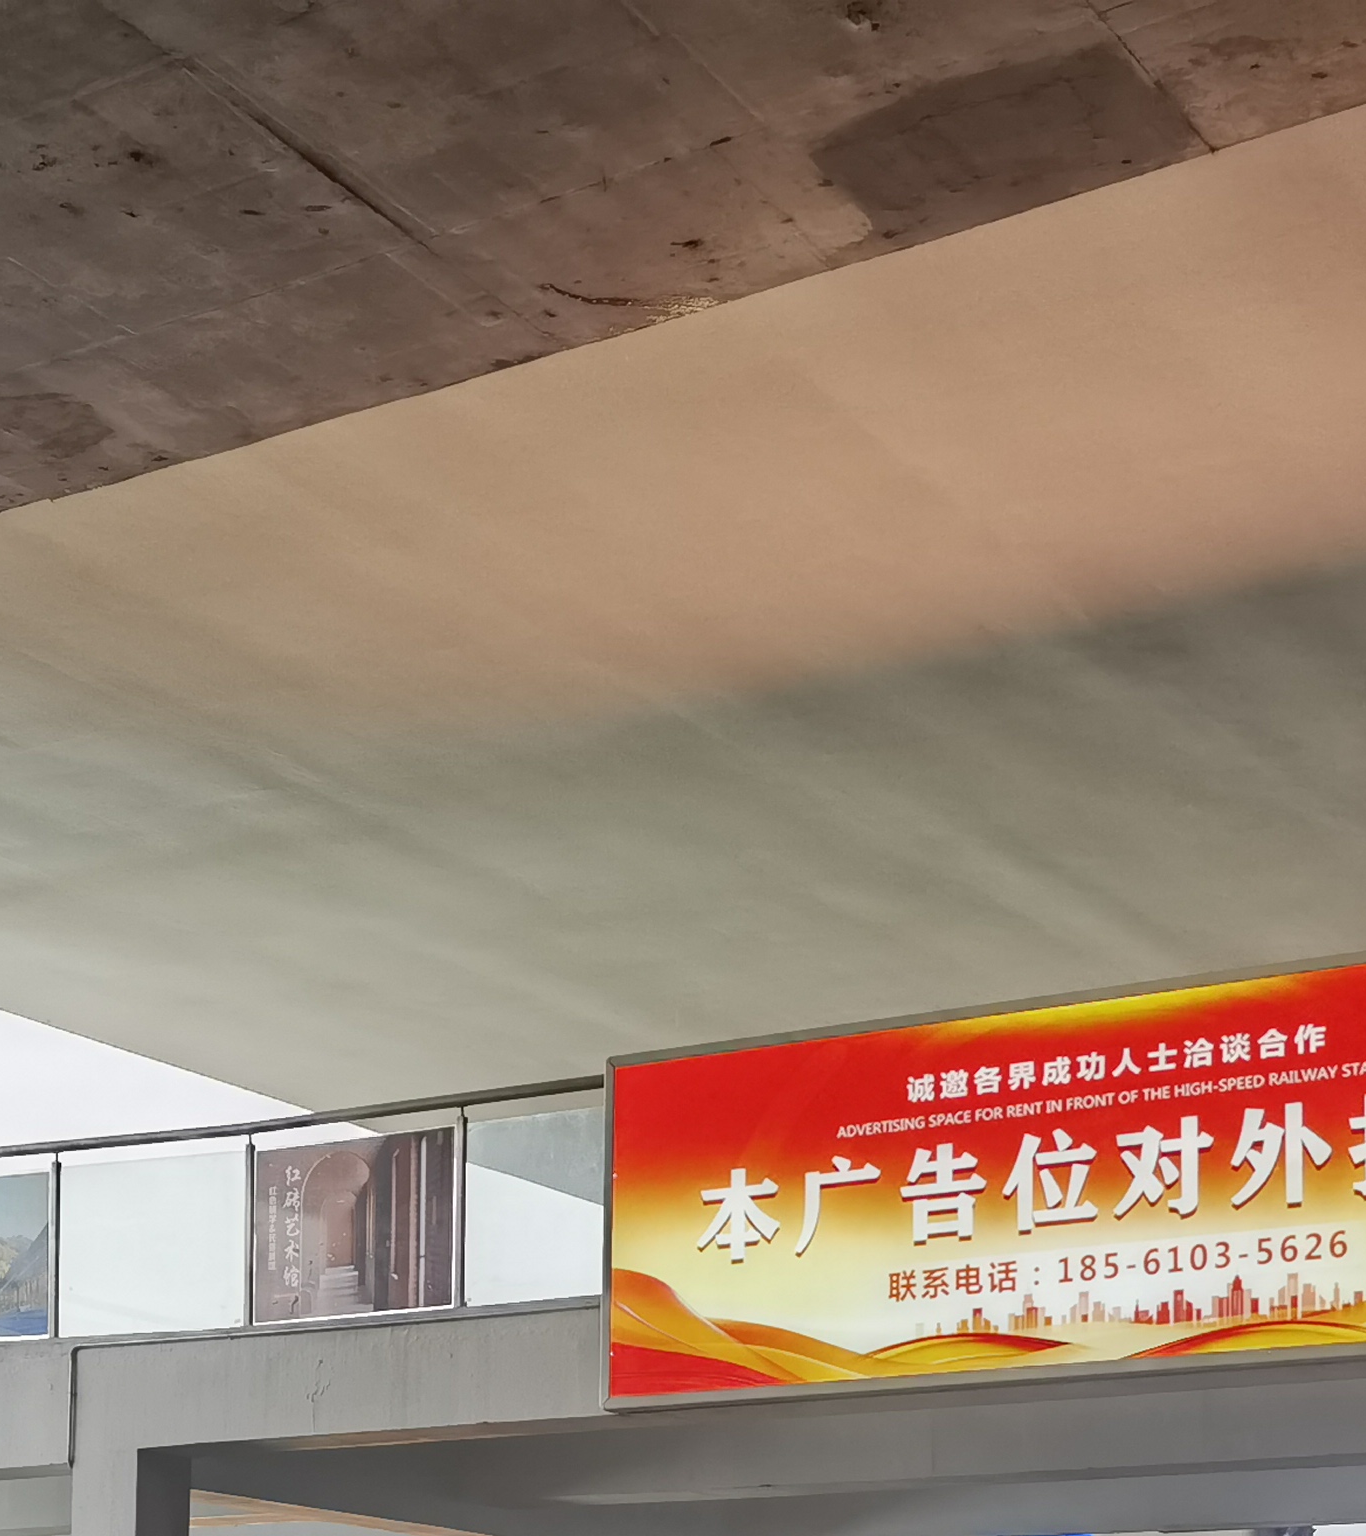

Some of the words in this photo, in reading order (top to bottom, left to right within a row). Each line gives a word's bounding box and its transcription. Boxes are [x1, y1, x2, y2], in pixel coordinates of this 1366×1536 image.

[906, 1023, 1327, 1103] 诚邀各界成功人士洽谈合作
[837, 1116, 925, 1138] ADVERTISING
[928, 1110, 971, 1128] SPACE
[975, 1106, 1003, 1121] FOR
[1006, 1102, 1042, 1118] RENT
[1045, 1100, 1062, 1113] IN
[1066, 1095, 1114, 1111] FRONT
[1118, 1089, 1139, 1105] OF
[1142, 1086, 1171, 1101] THE
[1174, 1075, 1265, 1097] HIGH-SPEED
[1268, 1065, 1338, 1086] RAILWAY
[888, 1230, 1350, 1302] 联系电话：185-6103-5626
